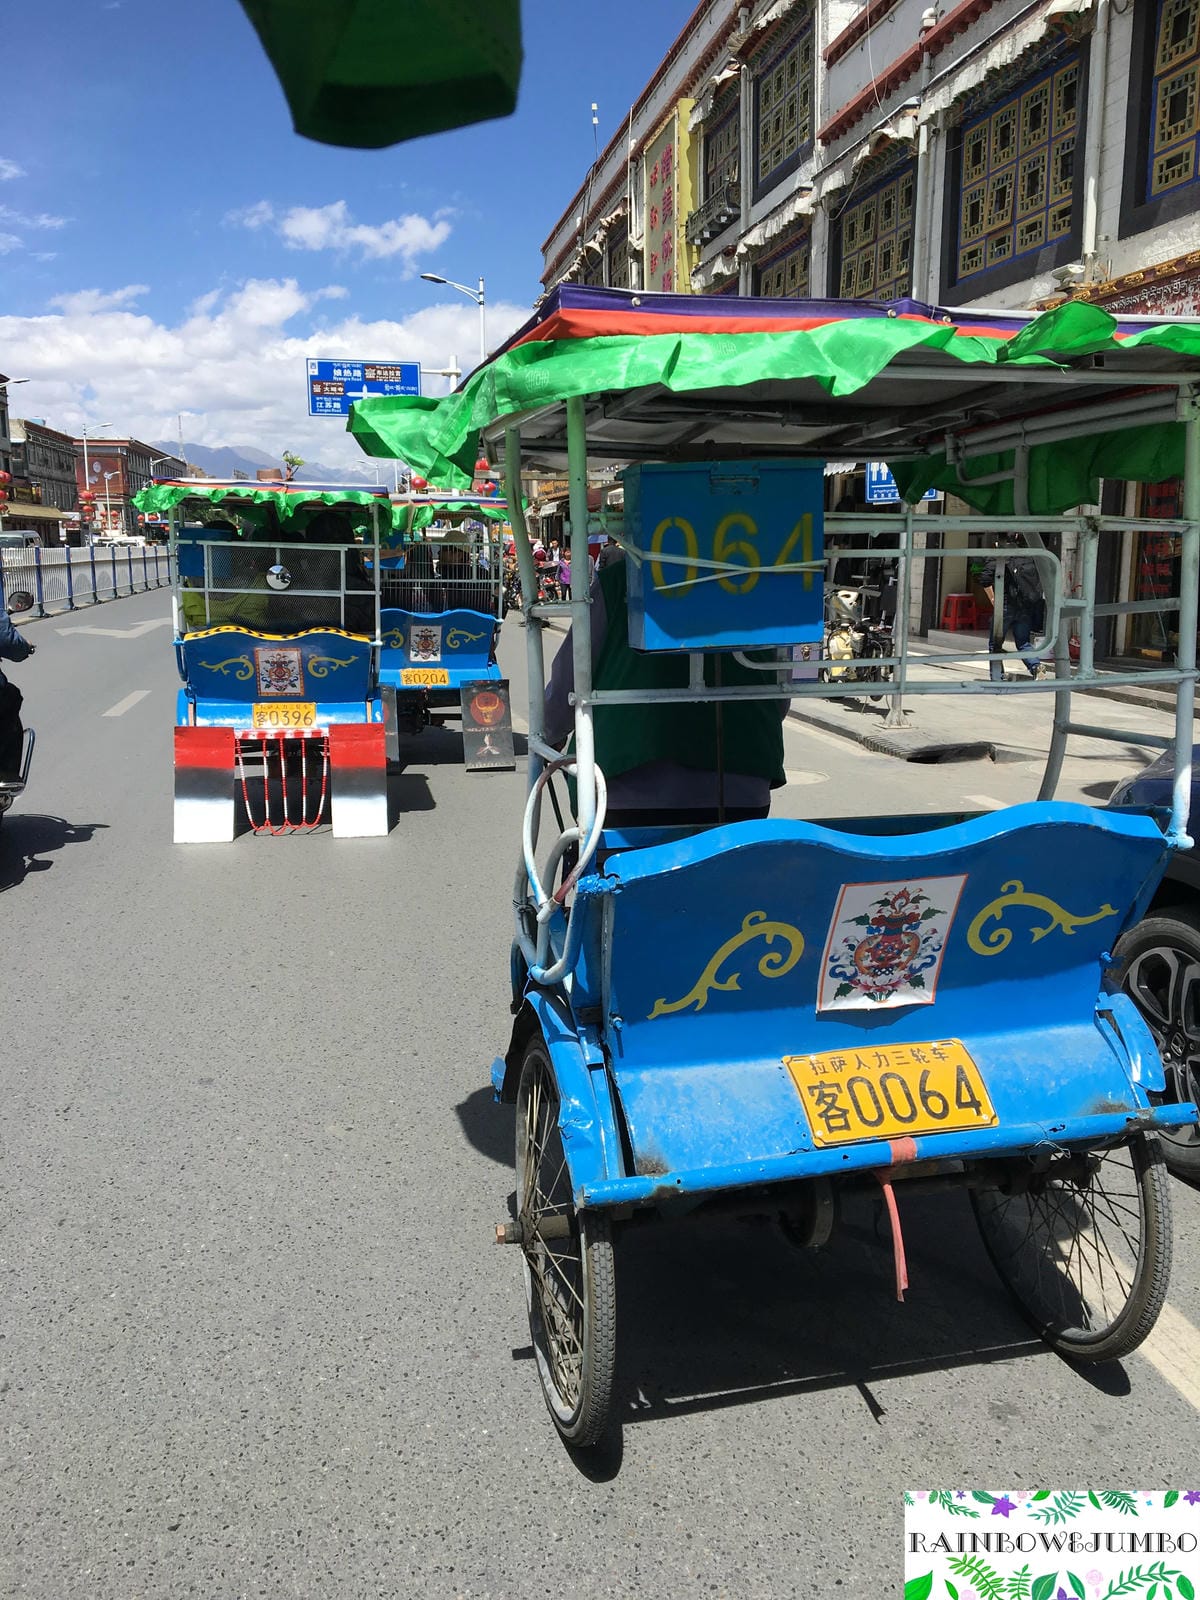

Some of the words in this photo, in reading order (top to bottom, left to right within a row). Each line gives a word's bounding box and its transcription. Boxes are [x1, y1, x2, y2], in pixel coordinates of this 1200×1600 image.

[316, 401, 341, 409] 江苏路
[651, 513, 814, 597] 064
[403, 673, 447, 685] 客0204
[256, 710, 313, 726] 客0396
[809, 1046, 950, 1076] 拉萨人力三轮车
[807, 1064, 982, 1134] 客0064
